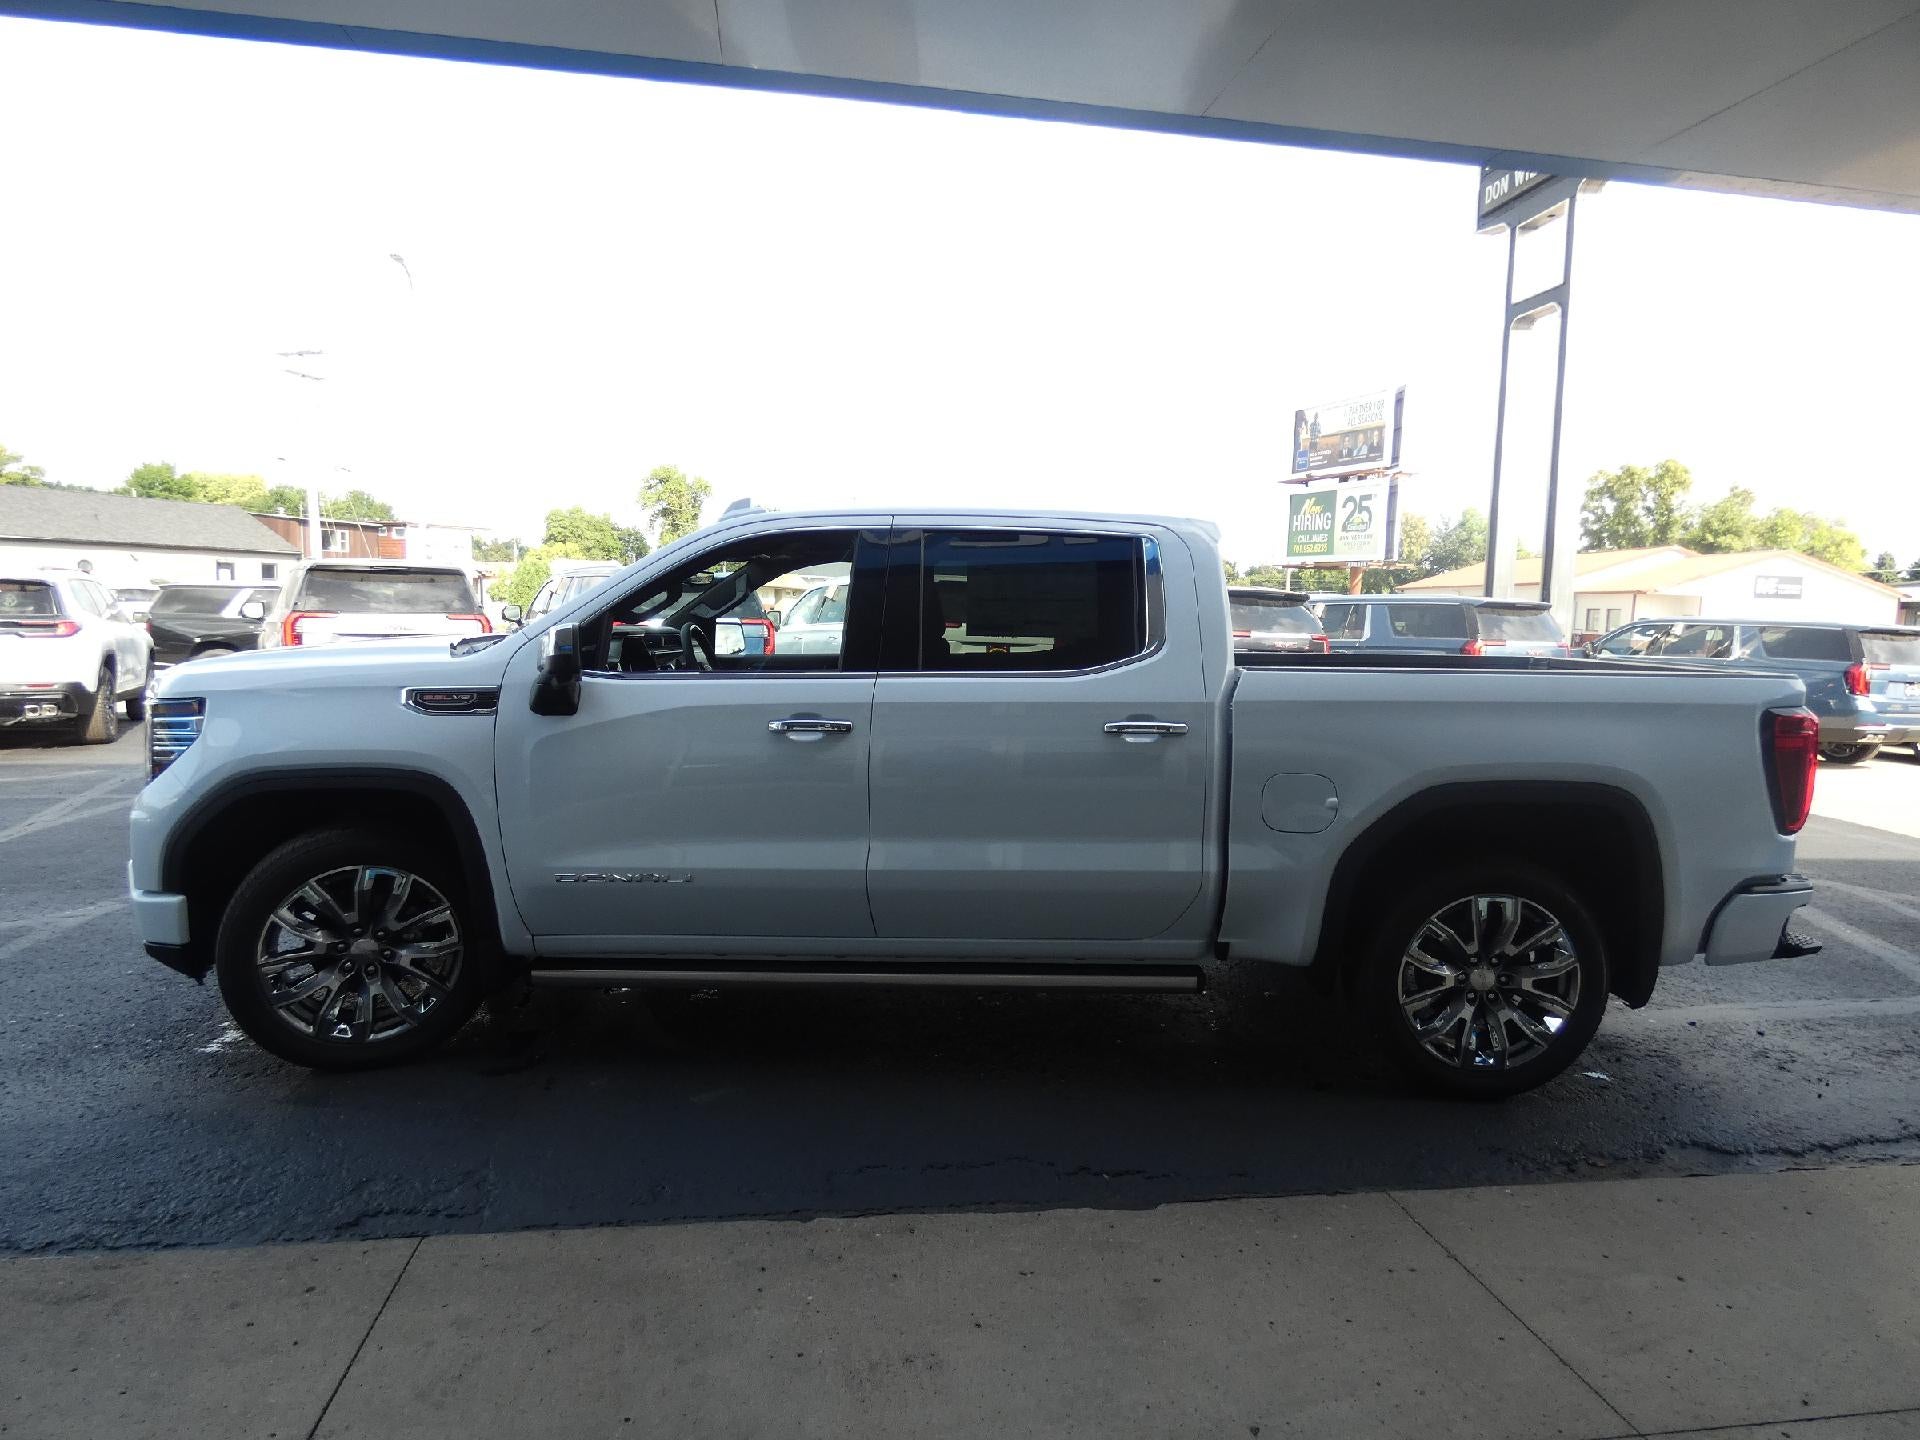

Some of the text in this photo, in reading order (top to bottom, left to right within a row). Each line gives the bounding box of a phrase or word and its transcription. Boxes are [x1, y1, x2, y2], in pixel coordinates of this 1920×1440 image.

[1485, 170, 1538, 204] DON WI
[1293, 512, 1331, 532] HIRING
[554, 872, 693, 883] DENALI
